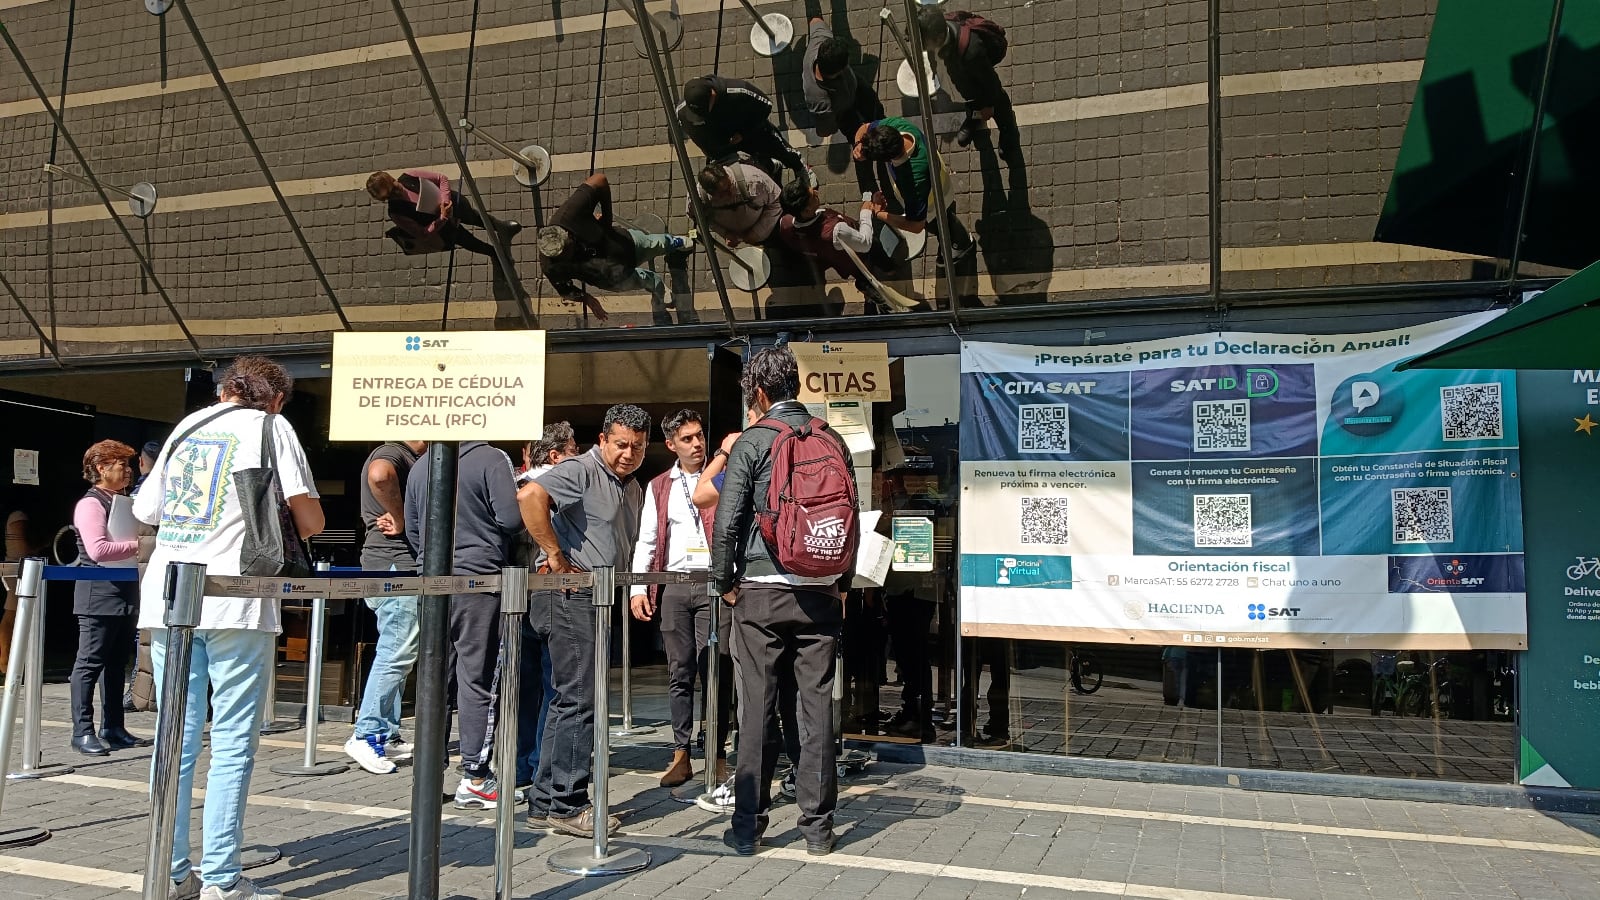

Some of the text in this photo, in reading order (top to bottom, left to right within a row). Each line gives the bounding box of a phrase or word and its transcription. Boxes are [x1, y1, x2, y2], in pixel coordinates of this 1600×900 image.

[422, 339, 449, 348] SAT
[1035, 334, 1410, 367] ¡Prepárate para tu Declaración Anual!
[352, 374, 524, 389] ENTREGA DE CÉDULA
[805, 371, 877, 394] CITAS
[359, 392, 516, 408] DE IDENTIFICACIÓN
[386, 413, 487, 429] FISCAL (RFC)
[1150, 468, 1182, 476] Genera
[1192, 468, 1229, 476] renueva
[1231, 467, 1241, 475] tu
[1243, 466, 1297, 474] Contraseña
[1332, 458, 1508, 473] Obtén tu Constancia de Situación Fiscal
[974, 469, 1116, 478] Renueva tu firma electrónica
[1364, 470, 1416, 481] Contraseña
[1426, 469, 1450, 477] firma
[1451, 467, 1505, 477] electrónica.
[1000, 480, 1039, 490] próxima
[1186, 478, 1196, 486] tu
[1197, 477, 1223, 485] firma
[1224, 476, 1280, 485] electrónica.
[806, 519, 846, 538] VANS
[1010, 567, 1040, 575] Virtual
[1168, 560, 1290, 573] Orientación fiscal
[1124, 576, 1175, 586] MarcaSAT:
[1176, 577, 1188, 586] 55
[1191, 577, 1214, 586] 6272
[1215, 578, 1240, 587] 2728
[1262, 578, 1287, 587] Chat
[1289, 579, 1309, 587] uno
[1320, 579, 1341, 587] uno
[1148, 603, 1225, 615] HACIENDA
[1268, 607, 1301, 617] SAT
